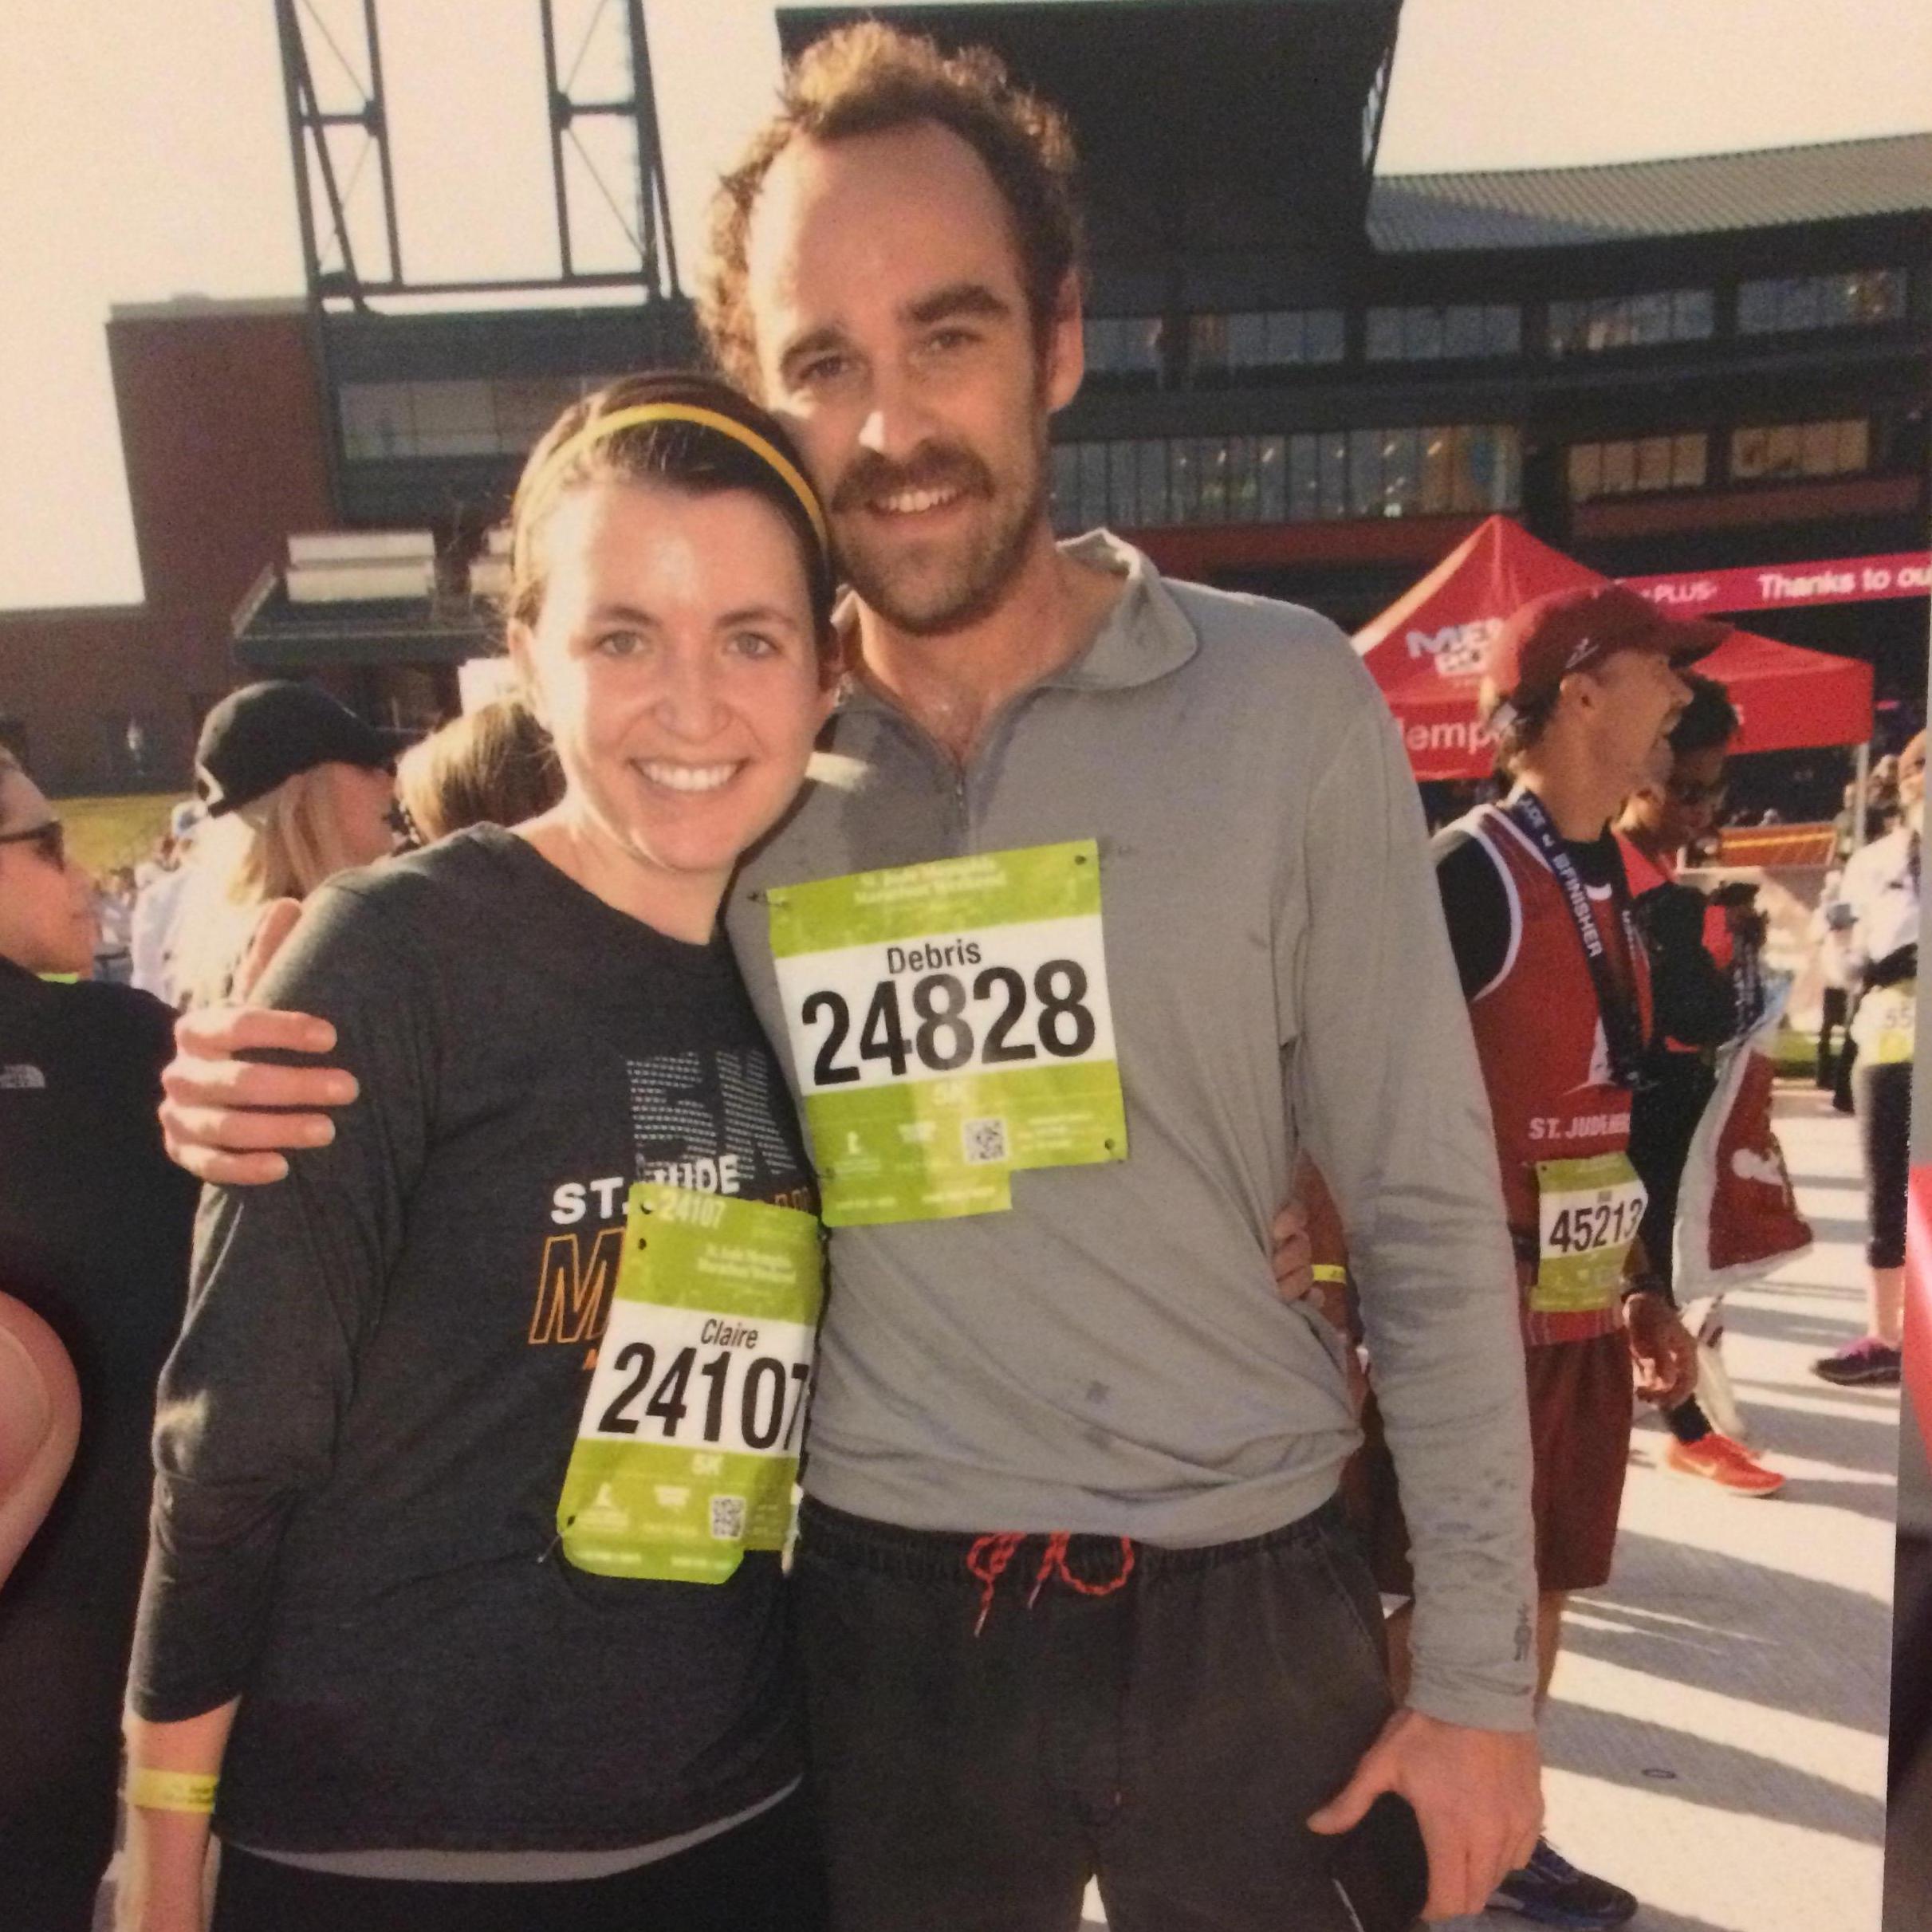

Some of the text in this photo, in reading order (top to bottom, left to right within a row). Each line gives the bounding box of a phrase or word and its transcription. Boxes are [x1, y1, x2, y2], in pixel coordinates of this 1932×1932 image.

[1757, 572, 1855, 600] Thanks
[1863, 568, 1891, 591] to
[1559, 866, 1603, 958] FINISHER
[887, 939, 982, 974] Debris
[801, 959, 1096, 1086] 24828
[1529, 1116, 1560, 1140] ST.
[550, 1176, 628, 1225] ST.
[1548, 1198, 1643, 1253] 45213
[700, 1317, 758, 1350] Claire
[597, 1341, 811, 1450] 24107
